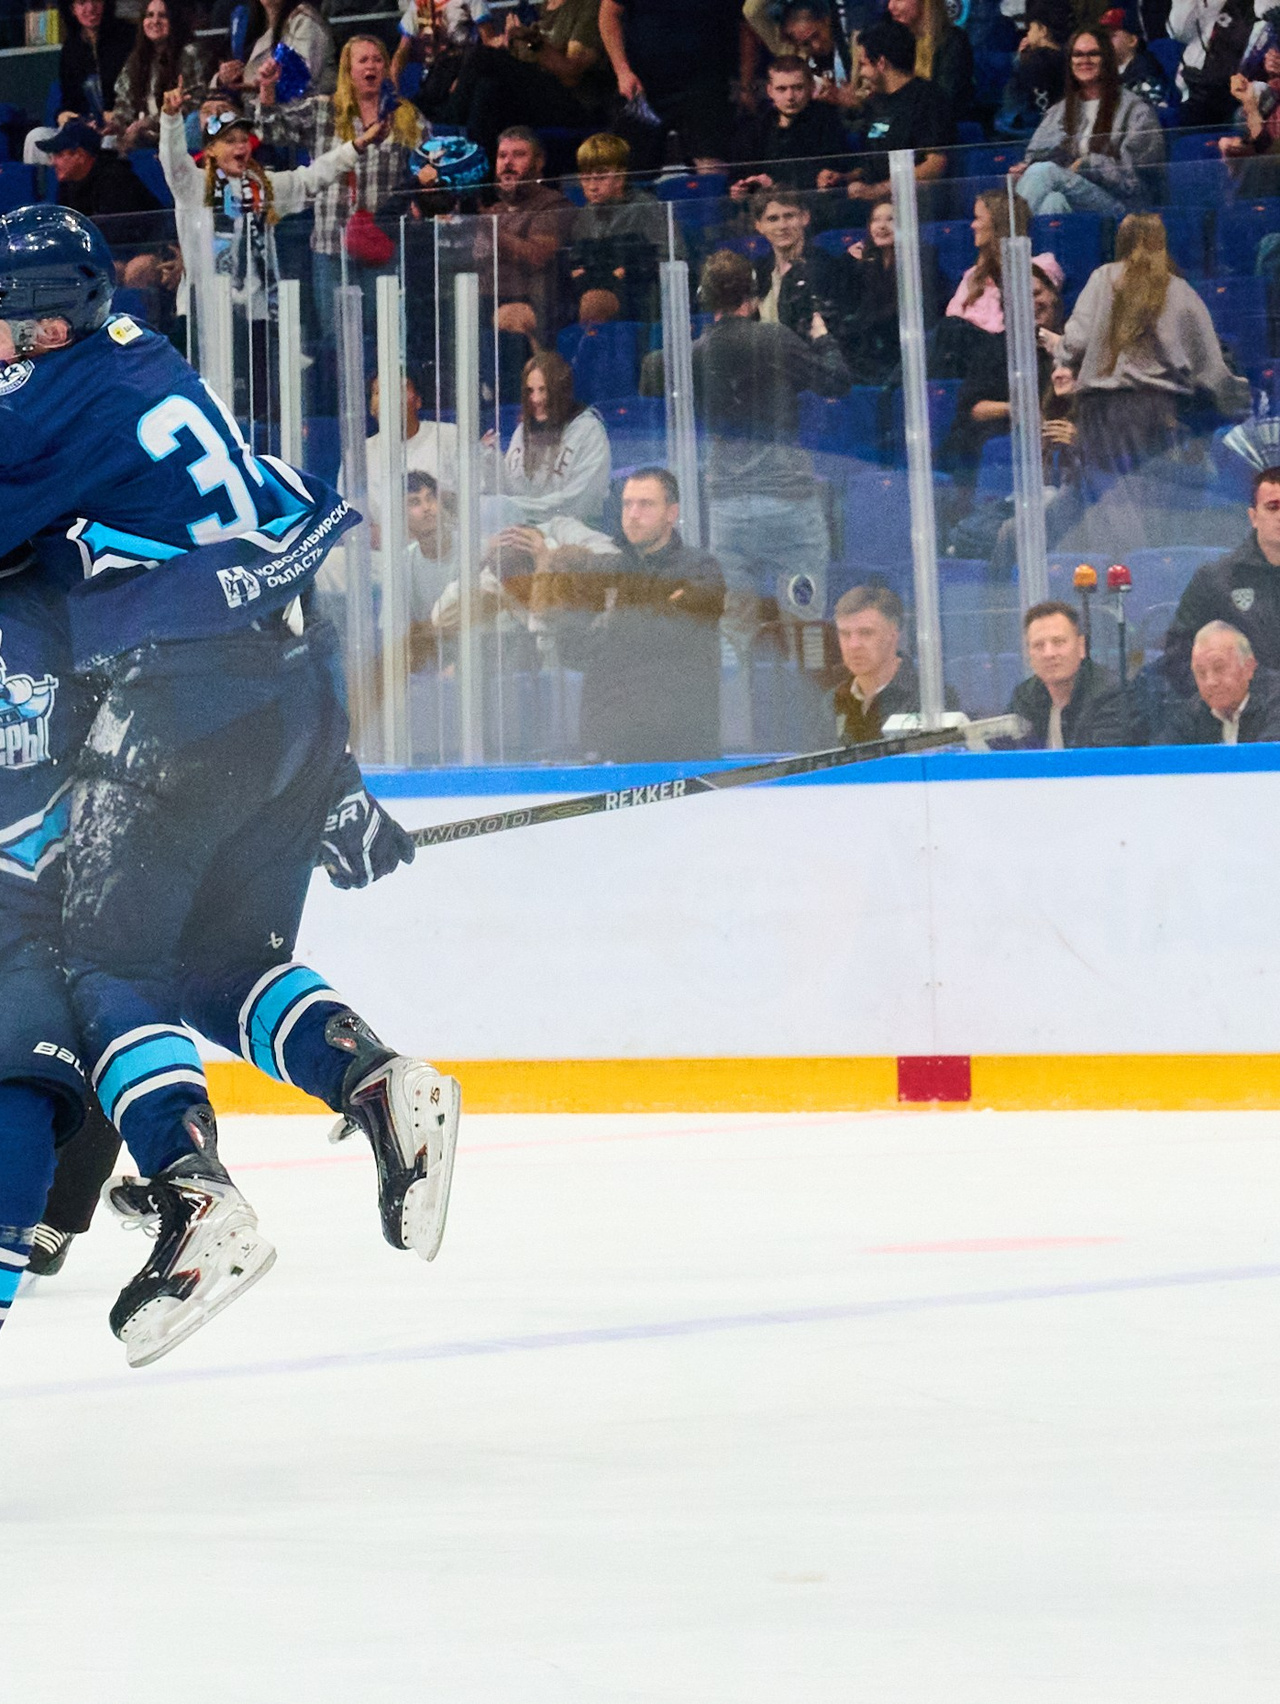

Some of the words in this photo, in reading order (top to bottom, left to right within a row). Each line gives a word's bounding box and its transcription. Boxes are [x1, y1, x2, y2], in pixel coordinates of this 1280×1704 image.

[253, 500, 353, 578] НОВОСИБИРСКА
[267, 547, 324, 588] ОБЛАСТЬ
[604, 780, 686, 811] REKKER
[415, 810, 532, 846] WOOD
